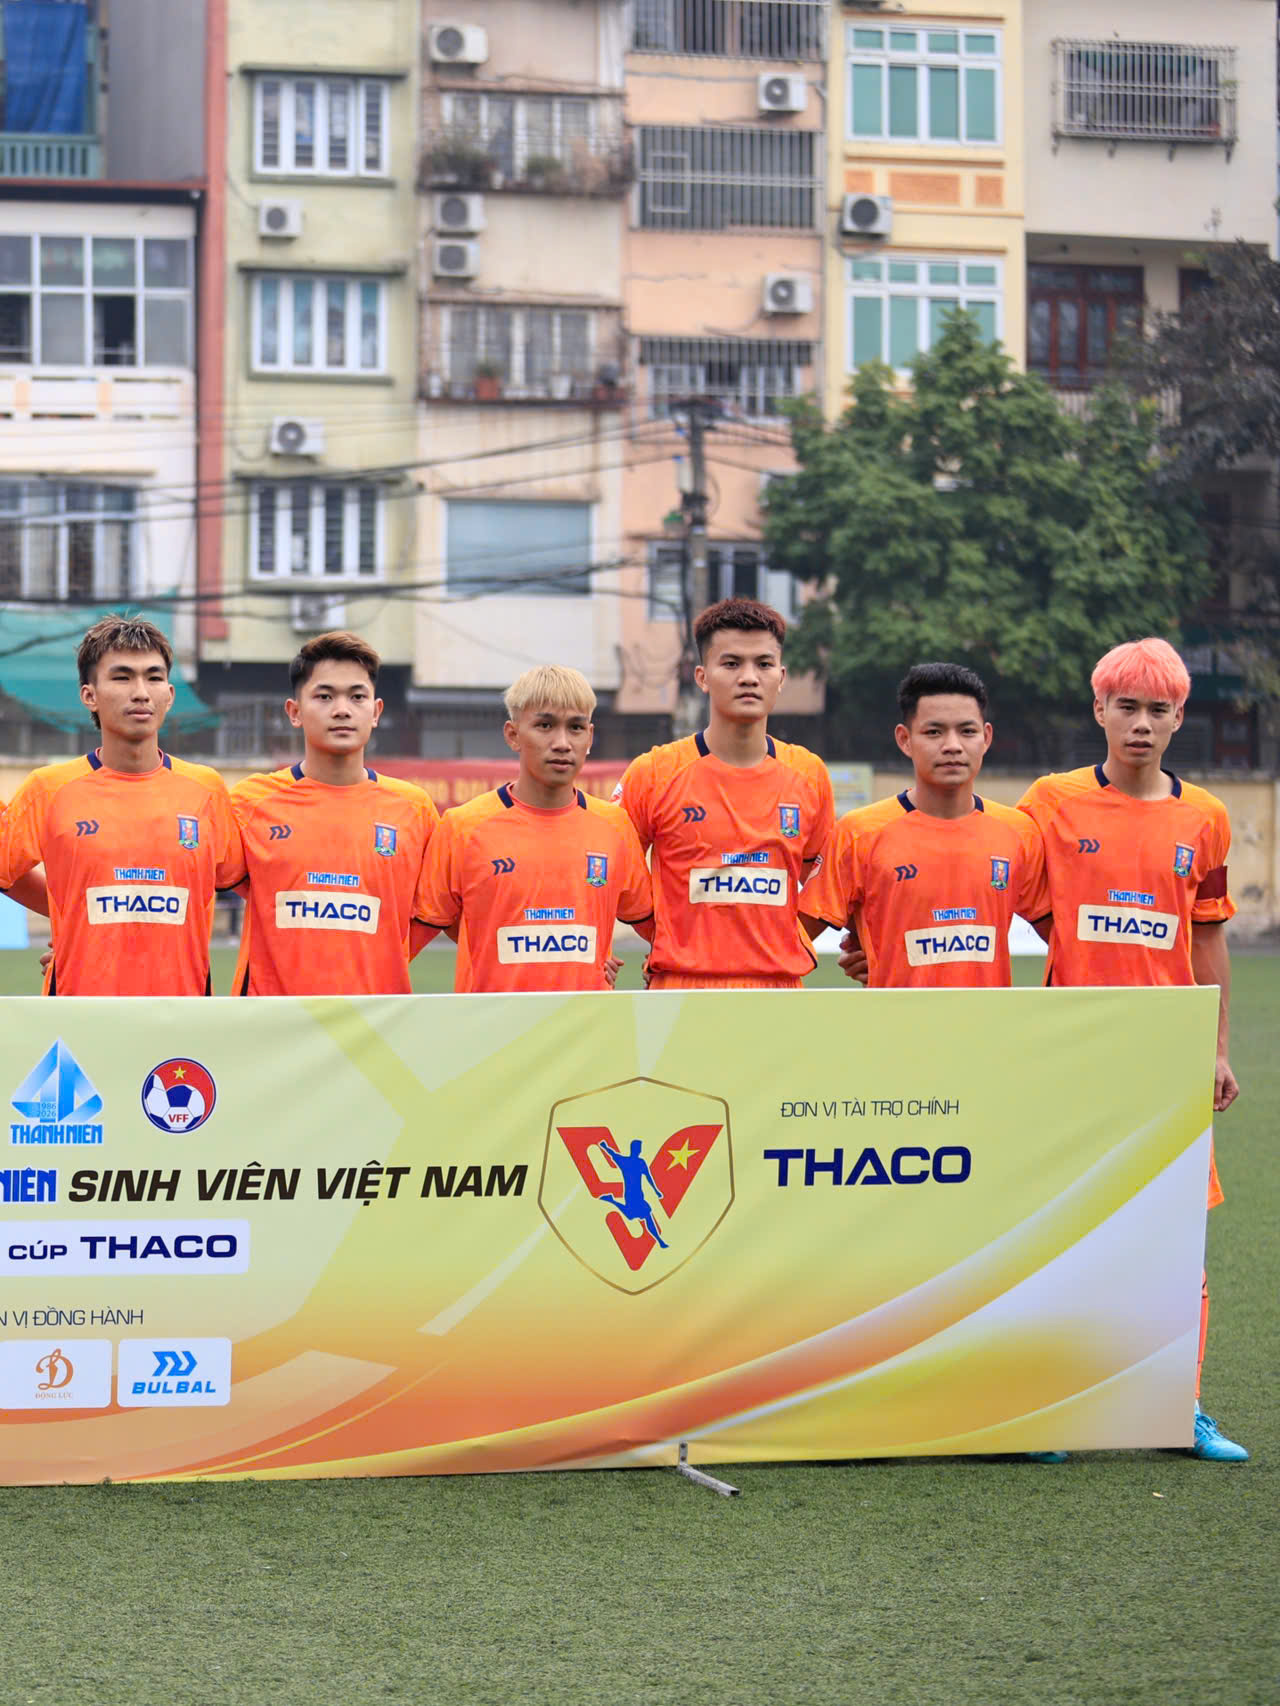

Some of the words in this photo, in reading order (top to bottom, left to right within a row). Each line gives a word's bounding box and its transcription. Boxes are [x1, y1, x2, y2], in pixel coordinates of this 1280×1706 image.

[699, 875, 781, 895] THACO
[96, 896, 180, 914] THACO
[285, 901, 371, 923] THACO
[1087, 914, 1169, 940] THACO
[507, 935, 589, 953] THACO
[915, 935, 990, 954] THACO
[780, 1100, 818, 1118] ĐƠN
[822, 1100, 837, 1119] VỊ
[841, 1097, 866, 1117] TÀI
[870, 1100, 904, 1119] TRỢ
[907, 1096, 960, 1116] CHÍNH
[167, 1113, 190, 1124] VFF
[10, 1124, 64, 1144] THANH
[763, 1146, 973, 1187] THACO
[68, 1169, 181, 1203] SINH
[197, 1161, 301, 1202] VIÊN
[316, 1159, 411, 1206] VIỆT
[420, 1164, 528, 1199] NAM
[7, 1239, 68, 1261] CÚP
[80, 1234, 238, 1260] THACO
[12, 1310, 28, 1329] VỊ
[32, 1305, 86, 1327] ĐỒNG
[90, 1305, 144, 1326] HÀNH
[131, 1380, 217, 1395] BULBAL
